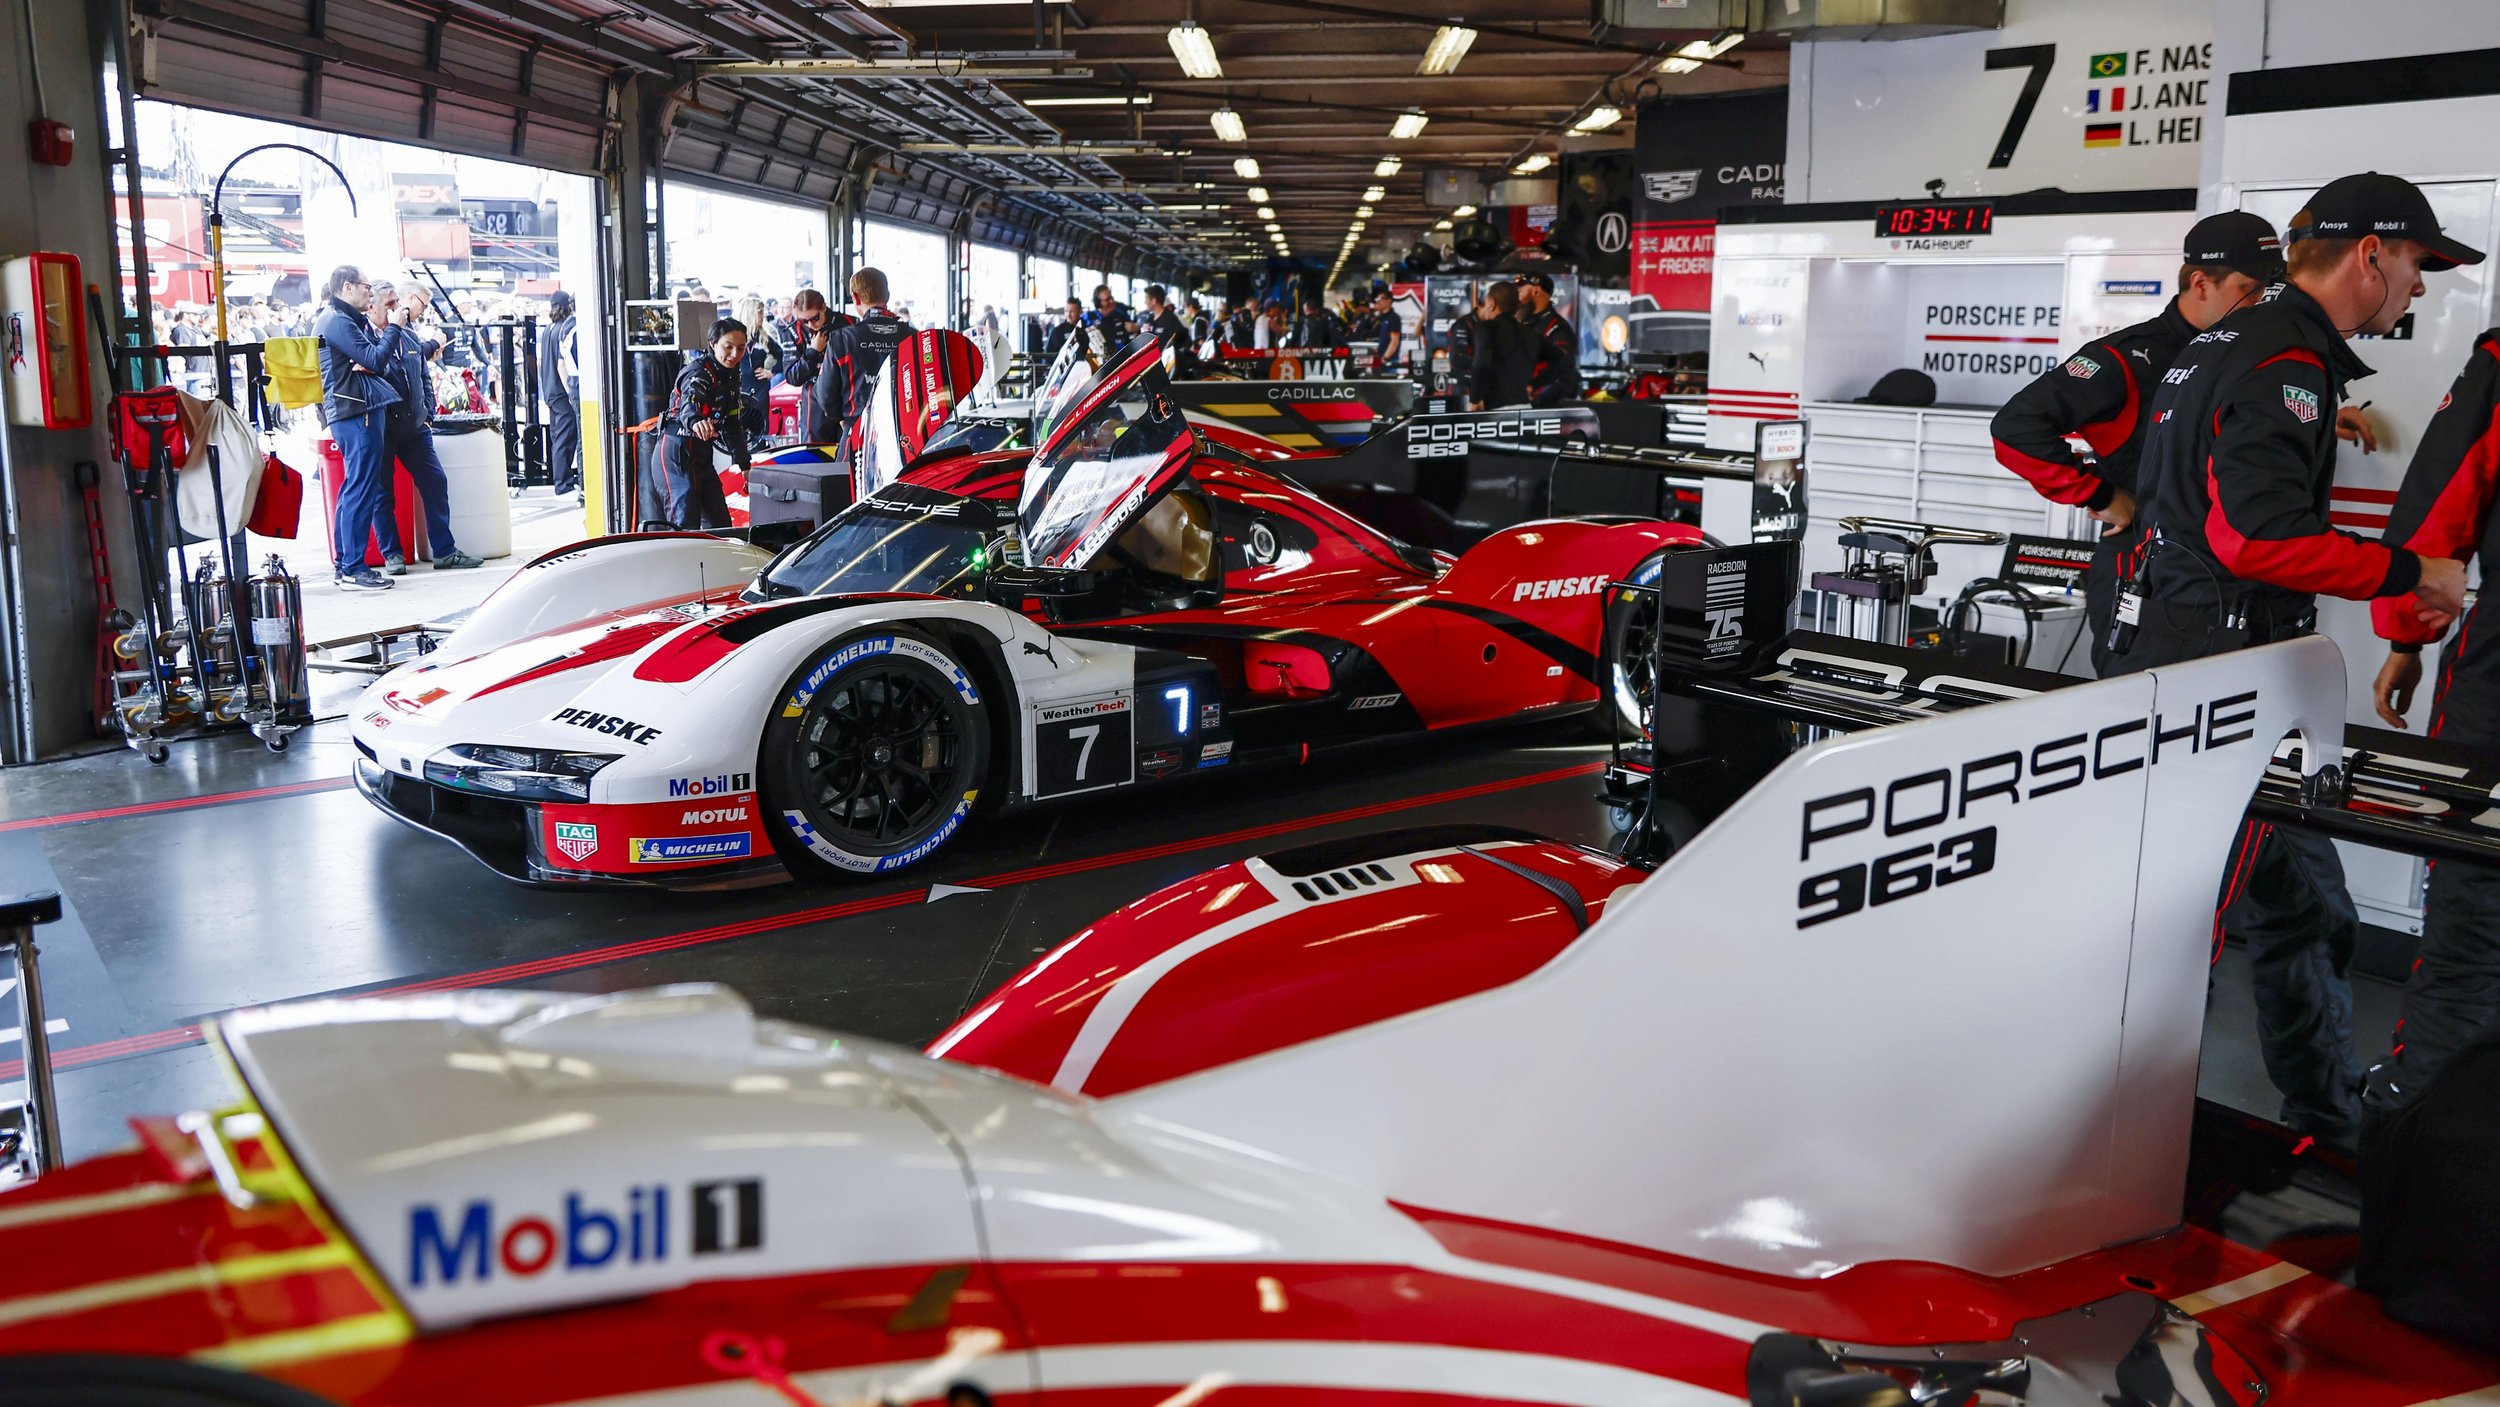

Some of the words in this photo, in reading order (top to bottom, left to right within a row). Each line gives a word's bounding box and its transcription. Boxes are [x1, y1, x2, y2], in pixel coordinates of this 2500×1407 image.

[2134, 50, 2154, 75] F.
[1983, 43, 2056, 170] 7
[2130, 85, 2149, 111] J.
[2129, 121, 2150, 146] L.
[1889, 208, 1992, 233] 10:34:11
[2374, 221, 2398, 231] Mobil
[1660, 235, 1691, 253] JACK
[1926, 305, 2027, 326] PORSCHE
[2033, 306, 2060, 327] PE
[2074, 356, 2097, 369] TAG
[1083, 376, 1121, 410] HEINRICH
[1268, 387, 1356, 399] CADILLAC
[2287, 388, 2317, 406] TAG
[1407, 419, 1561, 442] PORSCHE
[1407, 442, 1469, 459] 963
[2018, 543, 2065, 559] PORSCHE
[2065, 550, 2095, 562] PENS
[1707, 559, 1747, 575] RACEBORN
[1512, 575, 1609, 602] PENSKE
[1705, 607, 1744, 640] 75
[808, 640, 887, 690] MICHELIN
[900, 642, 924, 654] PILOT
[924, 650, 950, 669] SPORT
[1043, 699, 1126, 721] WeatherTech
[1166, 687, 1190, 733] 7
[552, 707, 663, 746] PENSKE
[1069, 724, 1100, 781] 7
[669, 775, 728, 797] Mobil
[1800, 690, 2258, 862] PORSCHE
[681, 808, 749, 825] MOTUL
[559, 825, 593, 839] TAG
[883, 817, 958, 869] MICHELIN
[559, 839, 595, 859] HEUER
[665, 840, 742, 855] MICHELIN
[819, 846, 847, 866] SPORT
[847, 859, 870, 869] PILOT
[1797, 825, 1998, 930] 963
[408, 1181, 670, 1290] Mobil
